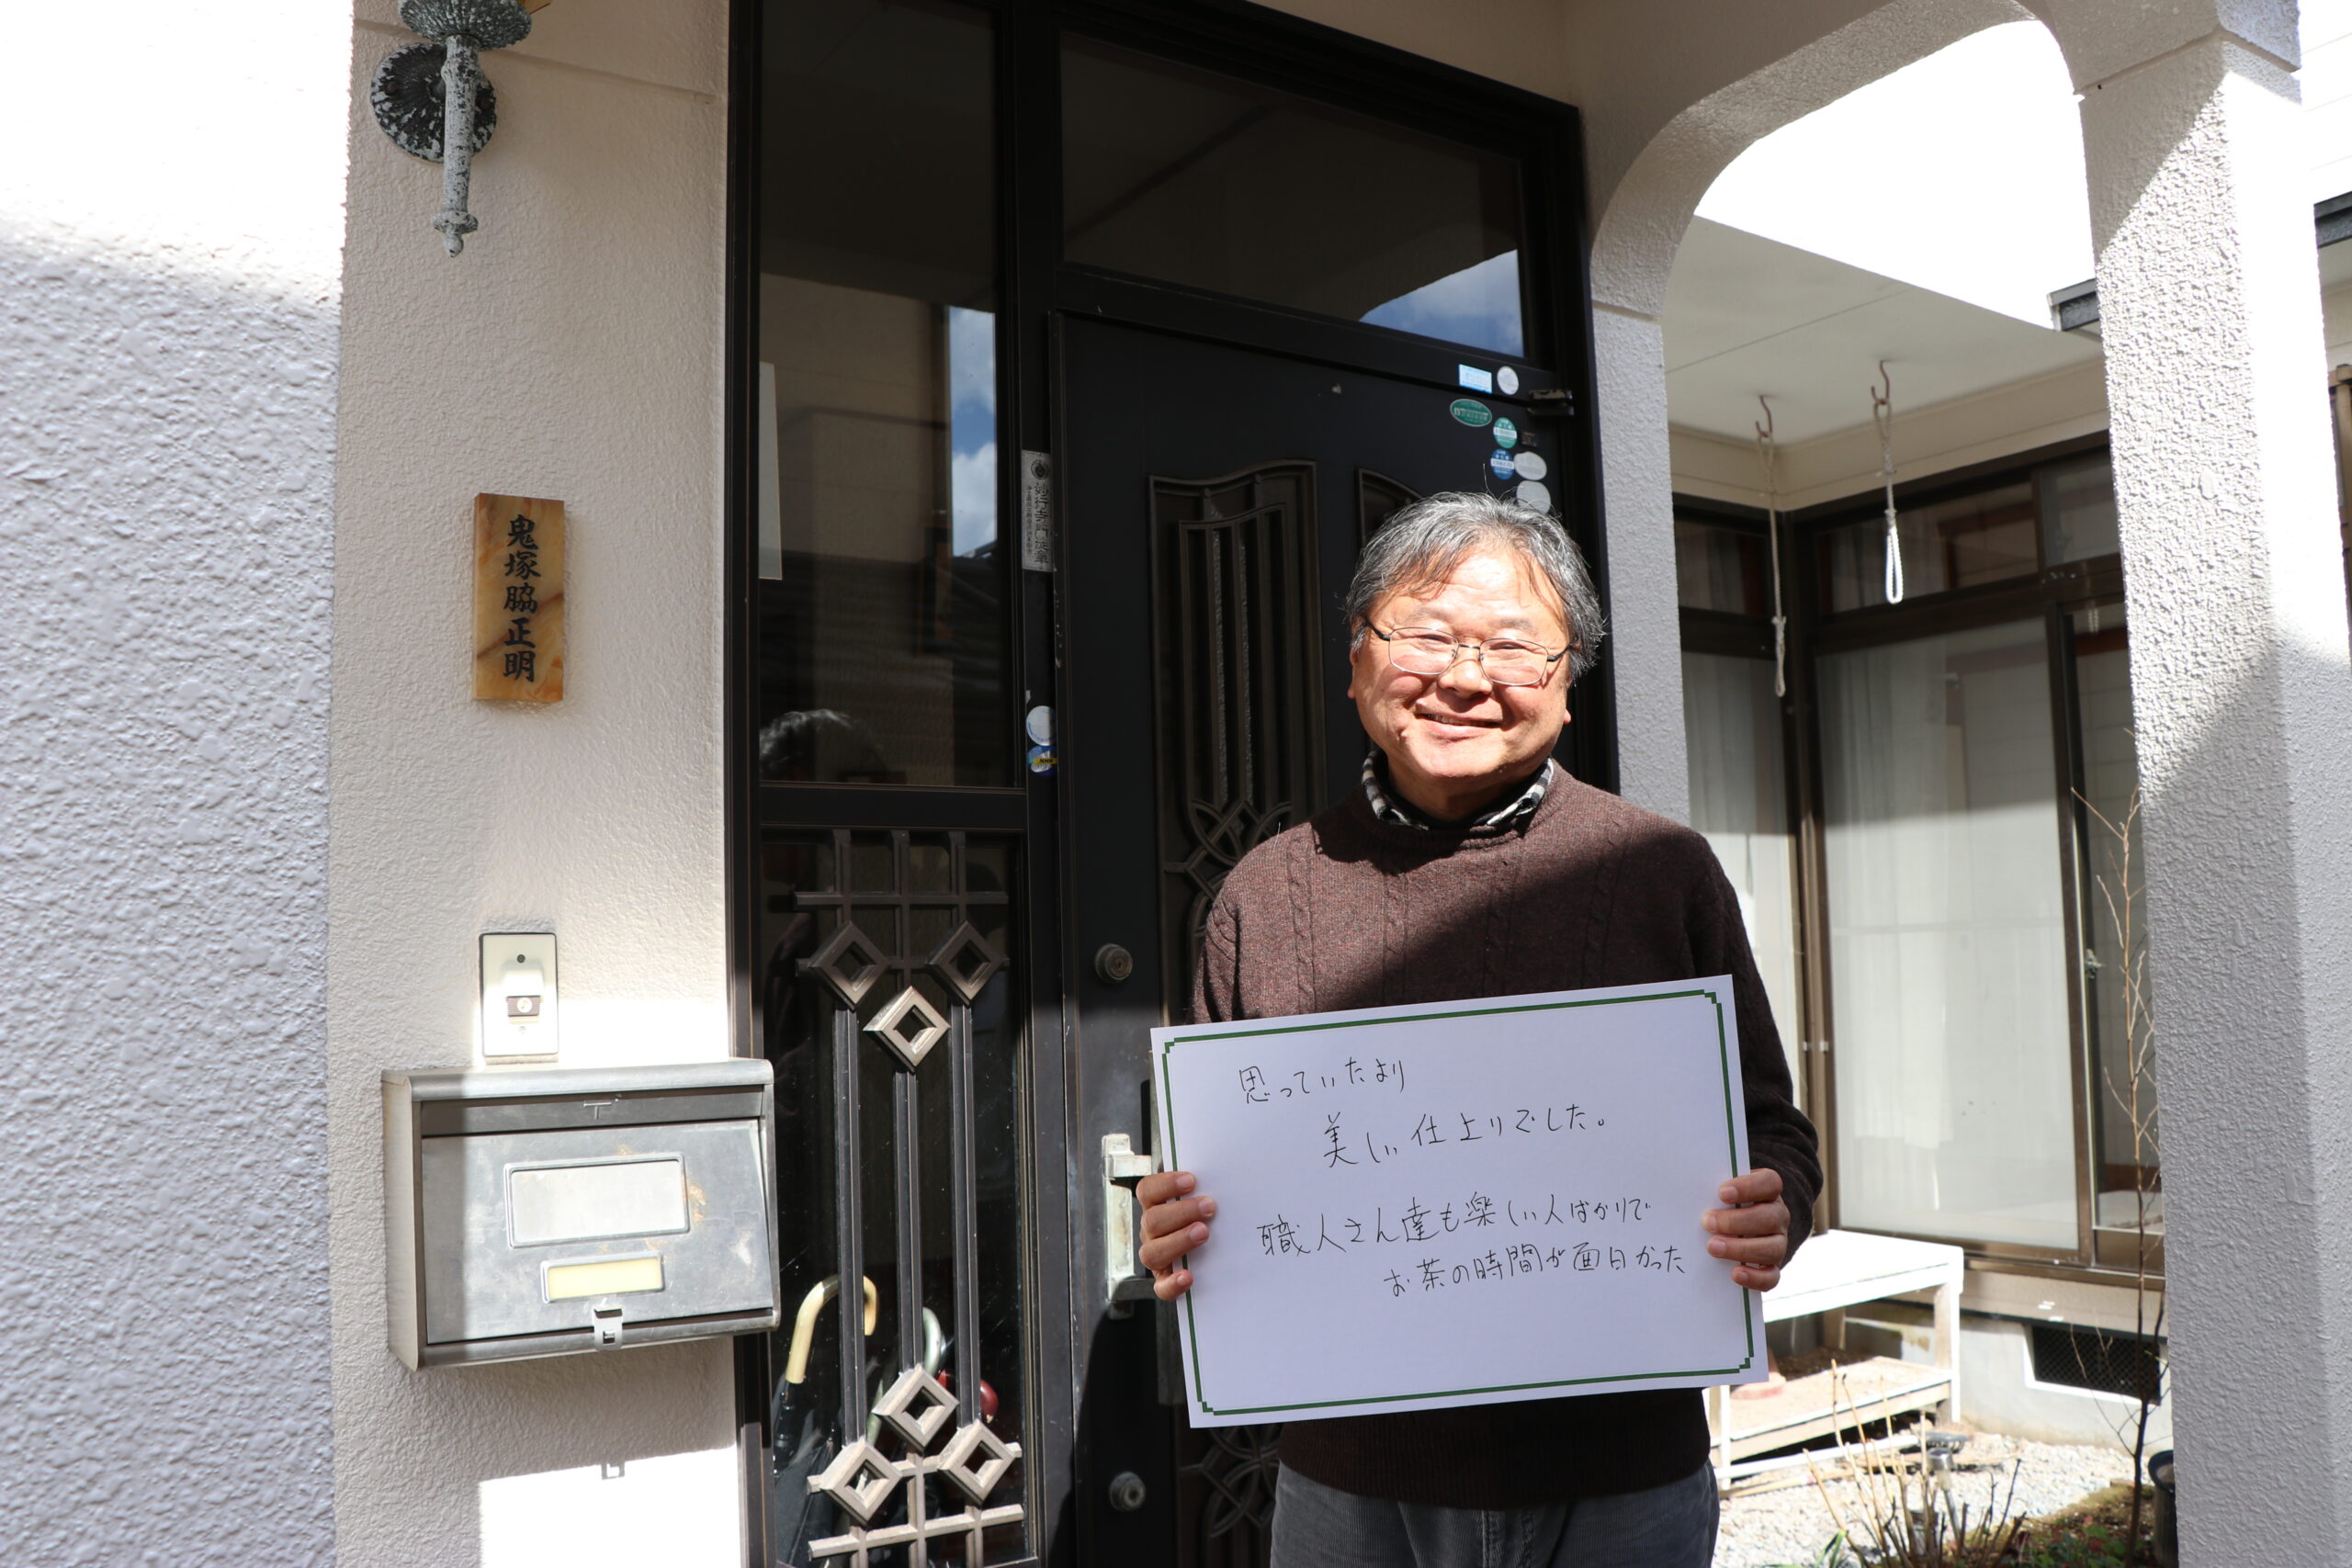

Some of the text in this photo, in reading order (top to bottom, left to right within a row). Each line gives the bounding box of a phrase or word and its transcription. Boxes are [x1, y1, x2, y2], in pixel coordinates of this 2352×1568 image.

[503, 513, 542, 683] 鬼塚脇正明
[1238, 1055, 1405, 1105] 思っていたより
